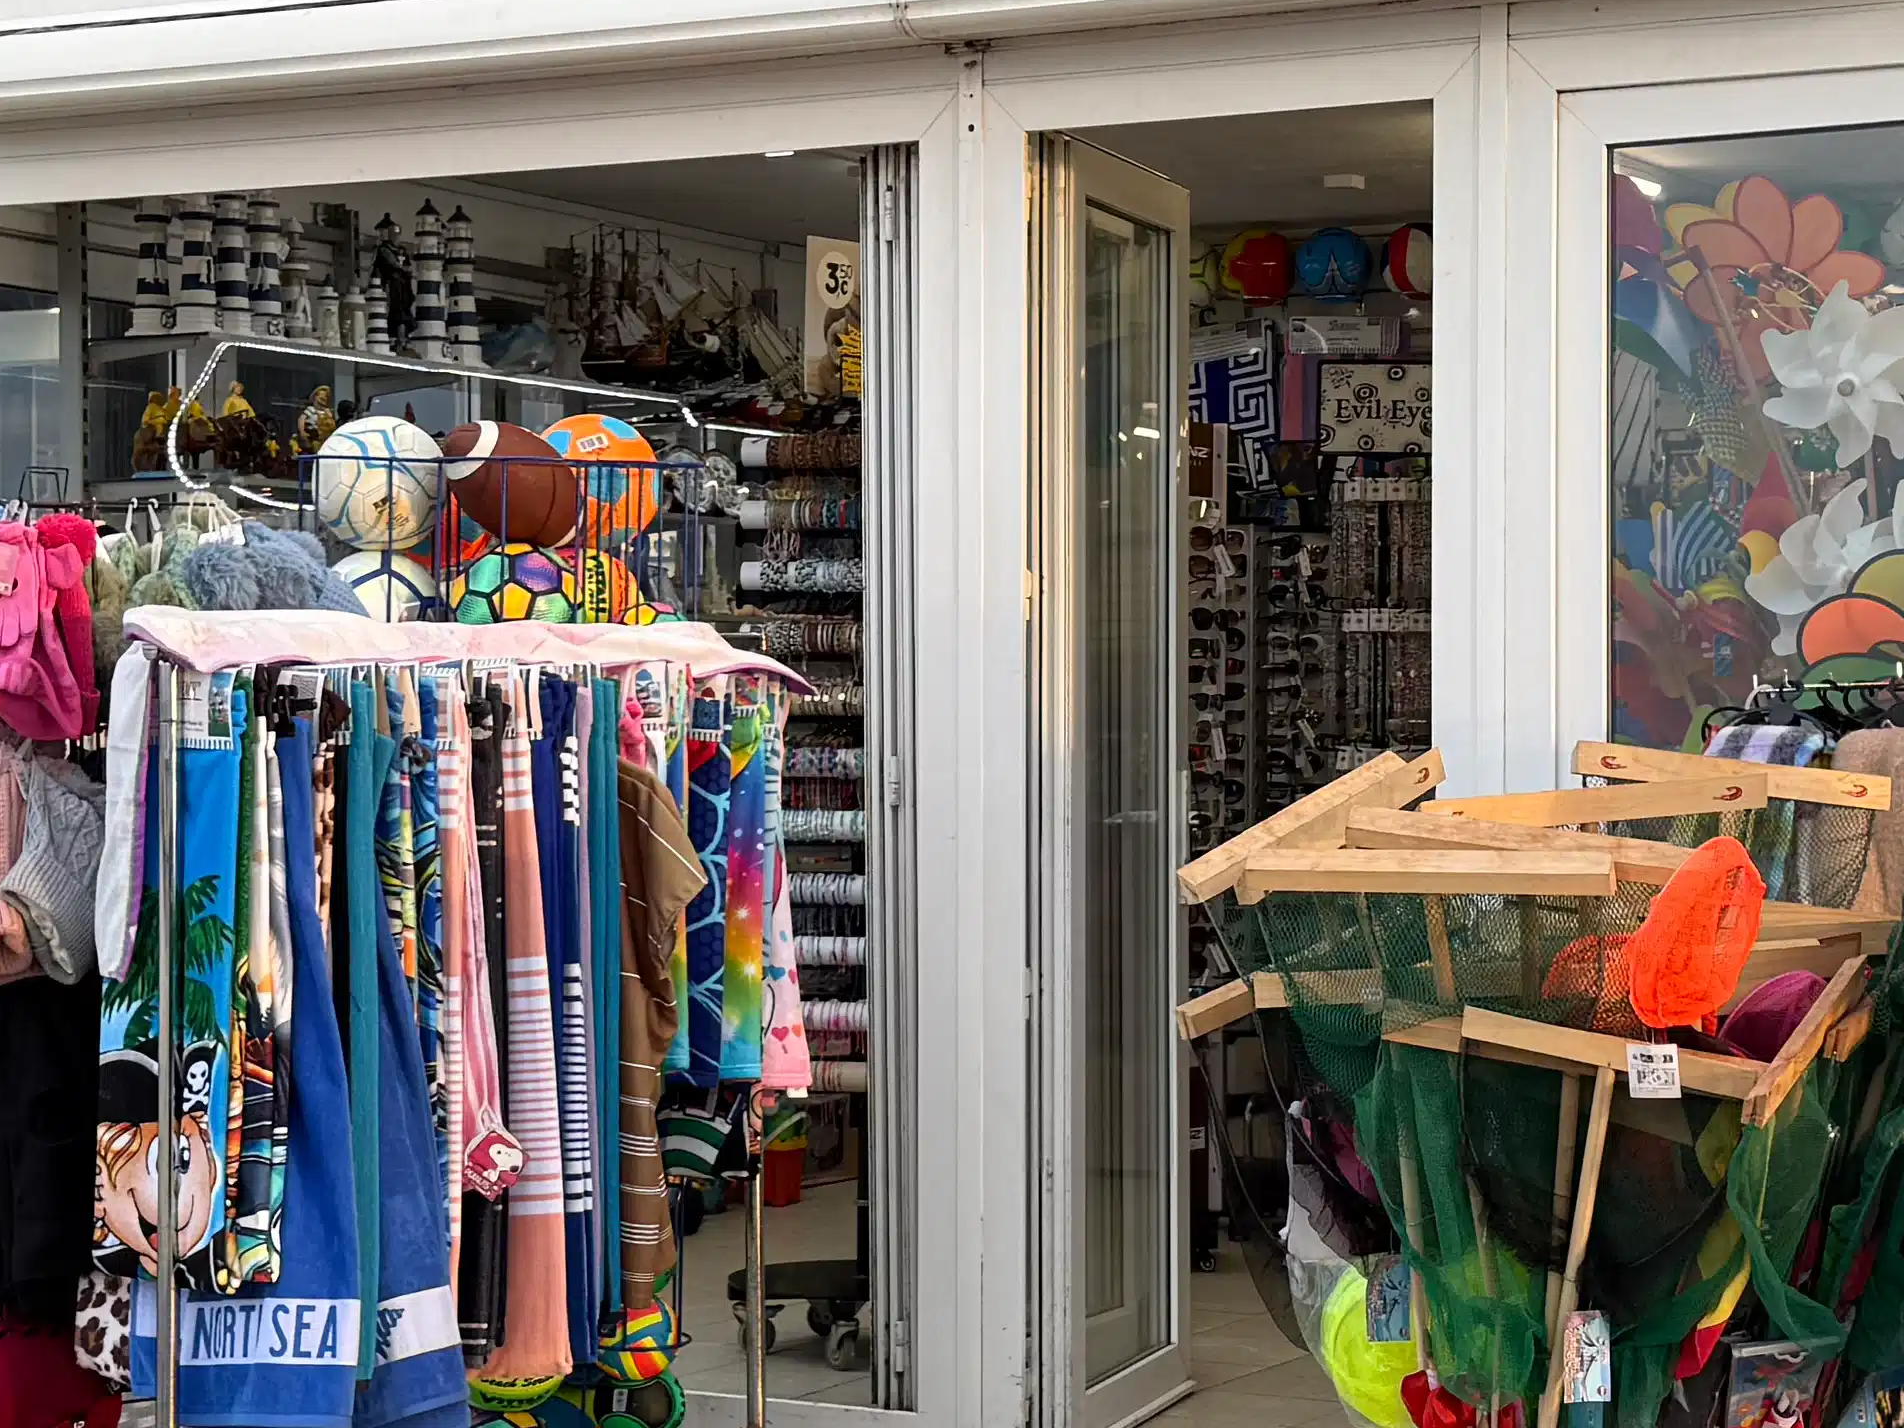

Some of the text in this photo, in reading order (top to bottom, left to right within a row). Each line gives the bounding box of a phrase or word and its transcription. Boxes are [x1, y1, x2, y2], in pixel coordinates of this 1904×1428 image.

[1335, 398, 1432, 424] Evil Eye
[191, 1303, 262, 1360] NORT
[268, 1302, 338, 1359] SEA
